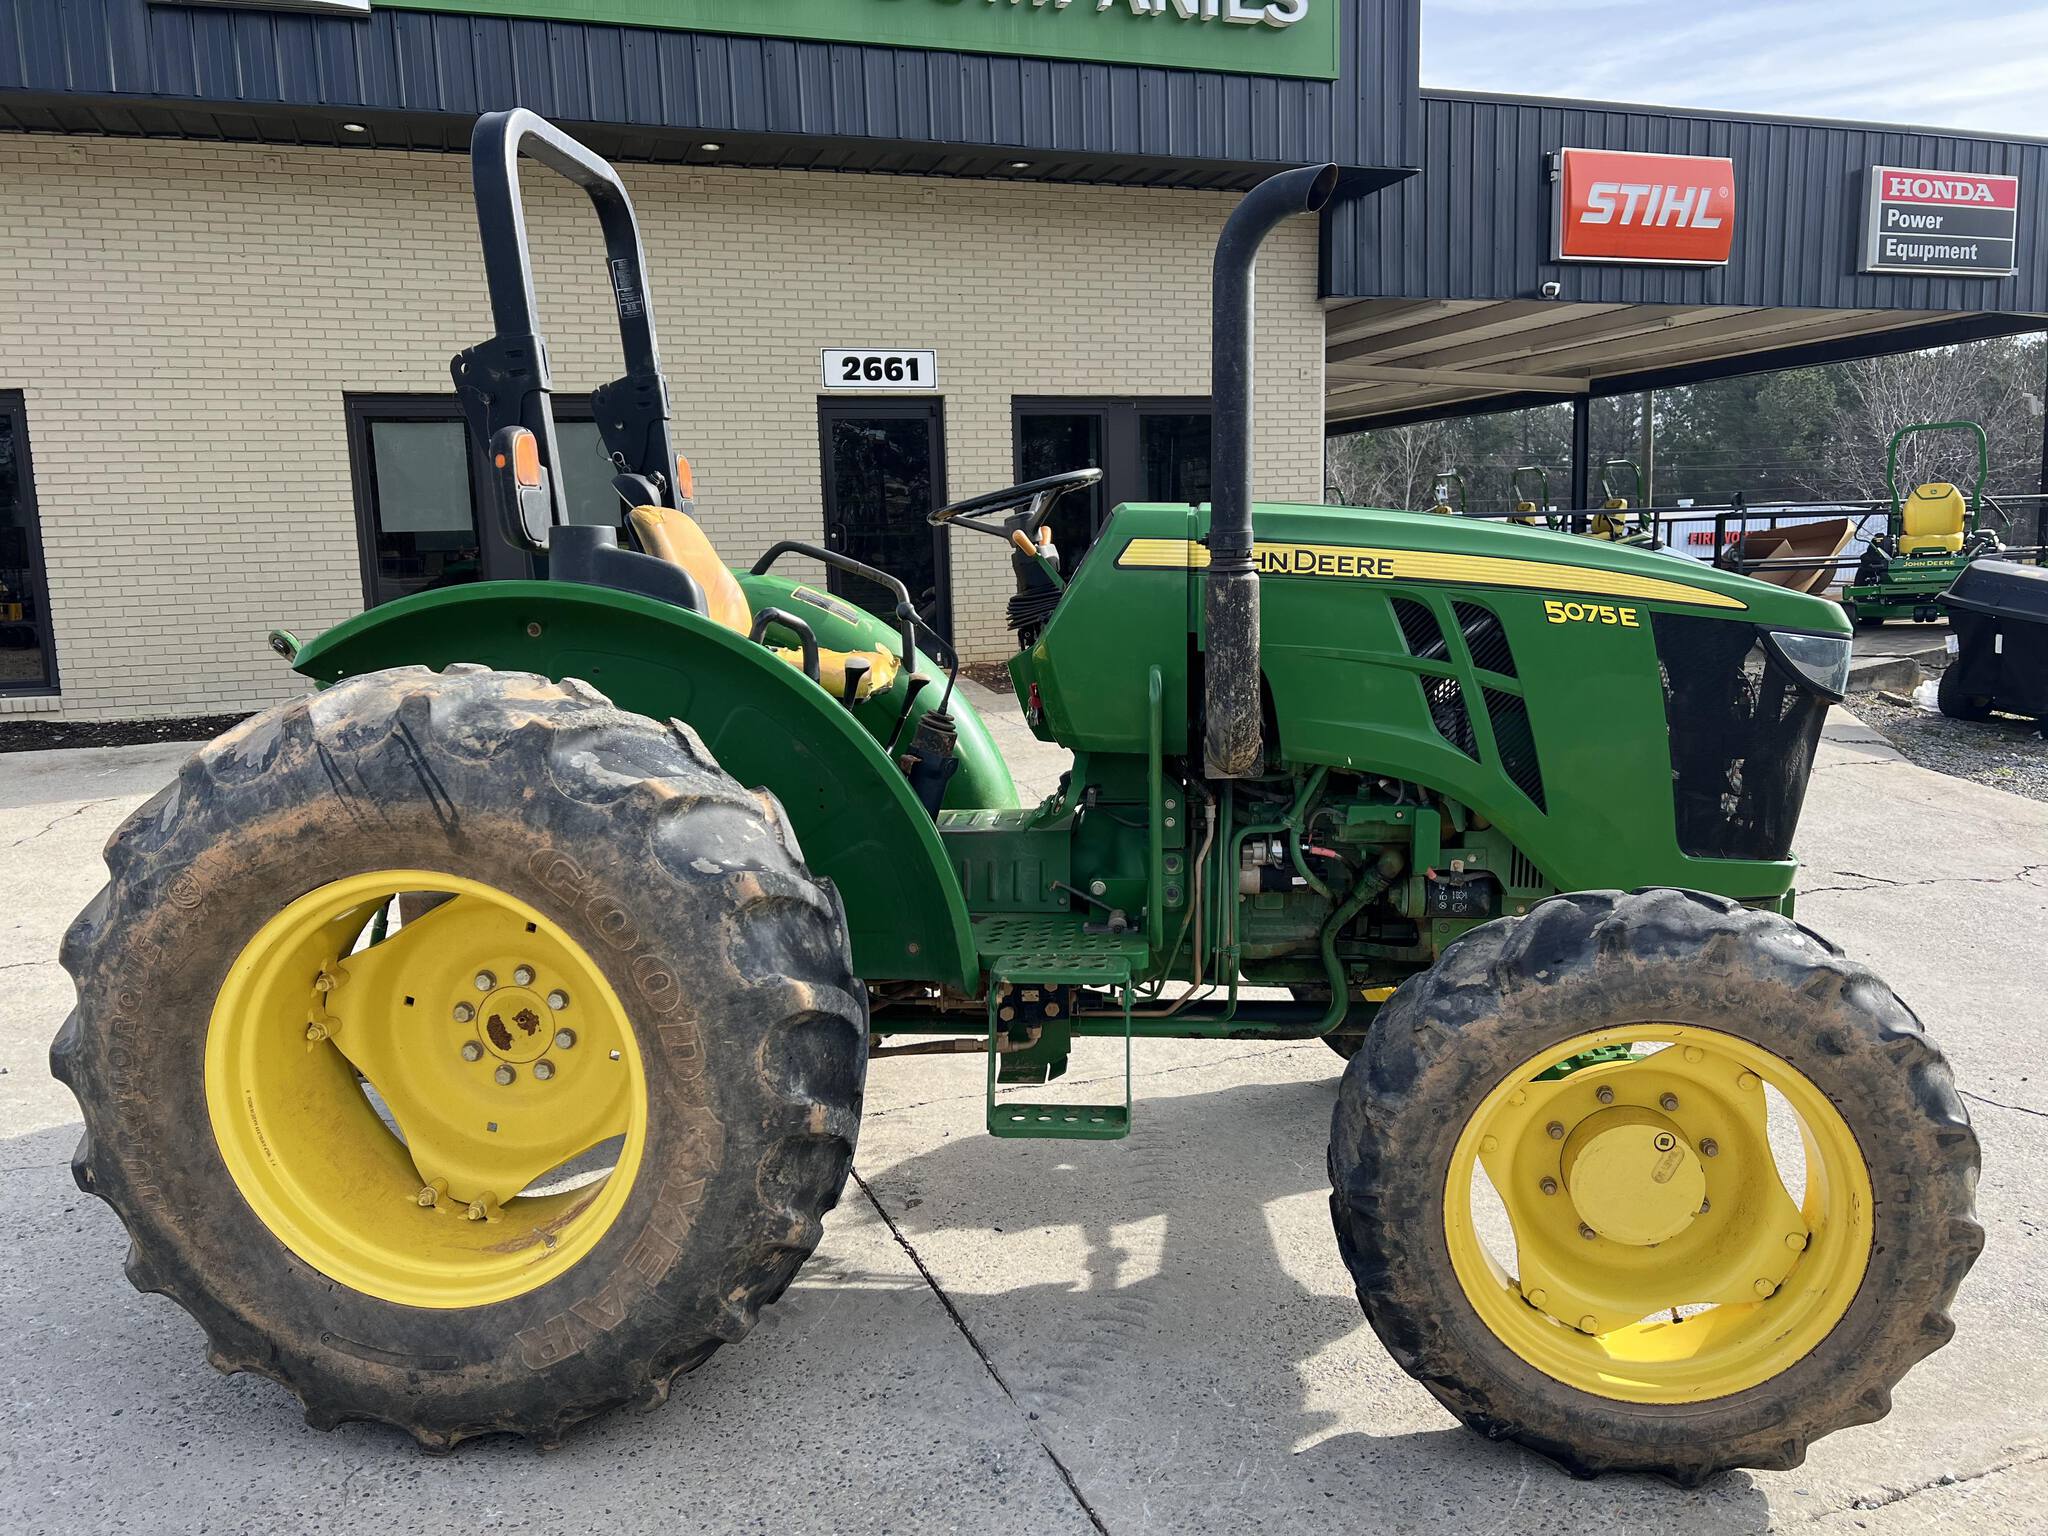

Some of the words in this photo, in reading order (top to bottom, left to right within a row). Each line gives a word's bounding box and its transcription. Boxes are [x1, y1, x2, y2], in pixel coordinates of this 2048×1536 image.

[1889, 177, 1994, 202] HONDA
[1580, 182, 1722, 229] STIHL
[1887, 209, 1943, 229] Power
[1886, 238, 1977, 261] Equipment
[842, 356, 919, 381] 2661
[1294, 549, 1394, 576] DEERE
